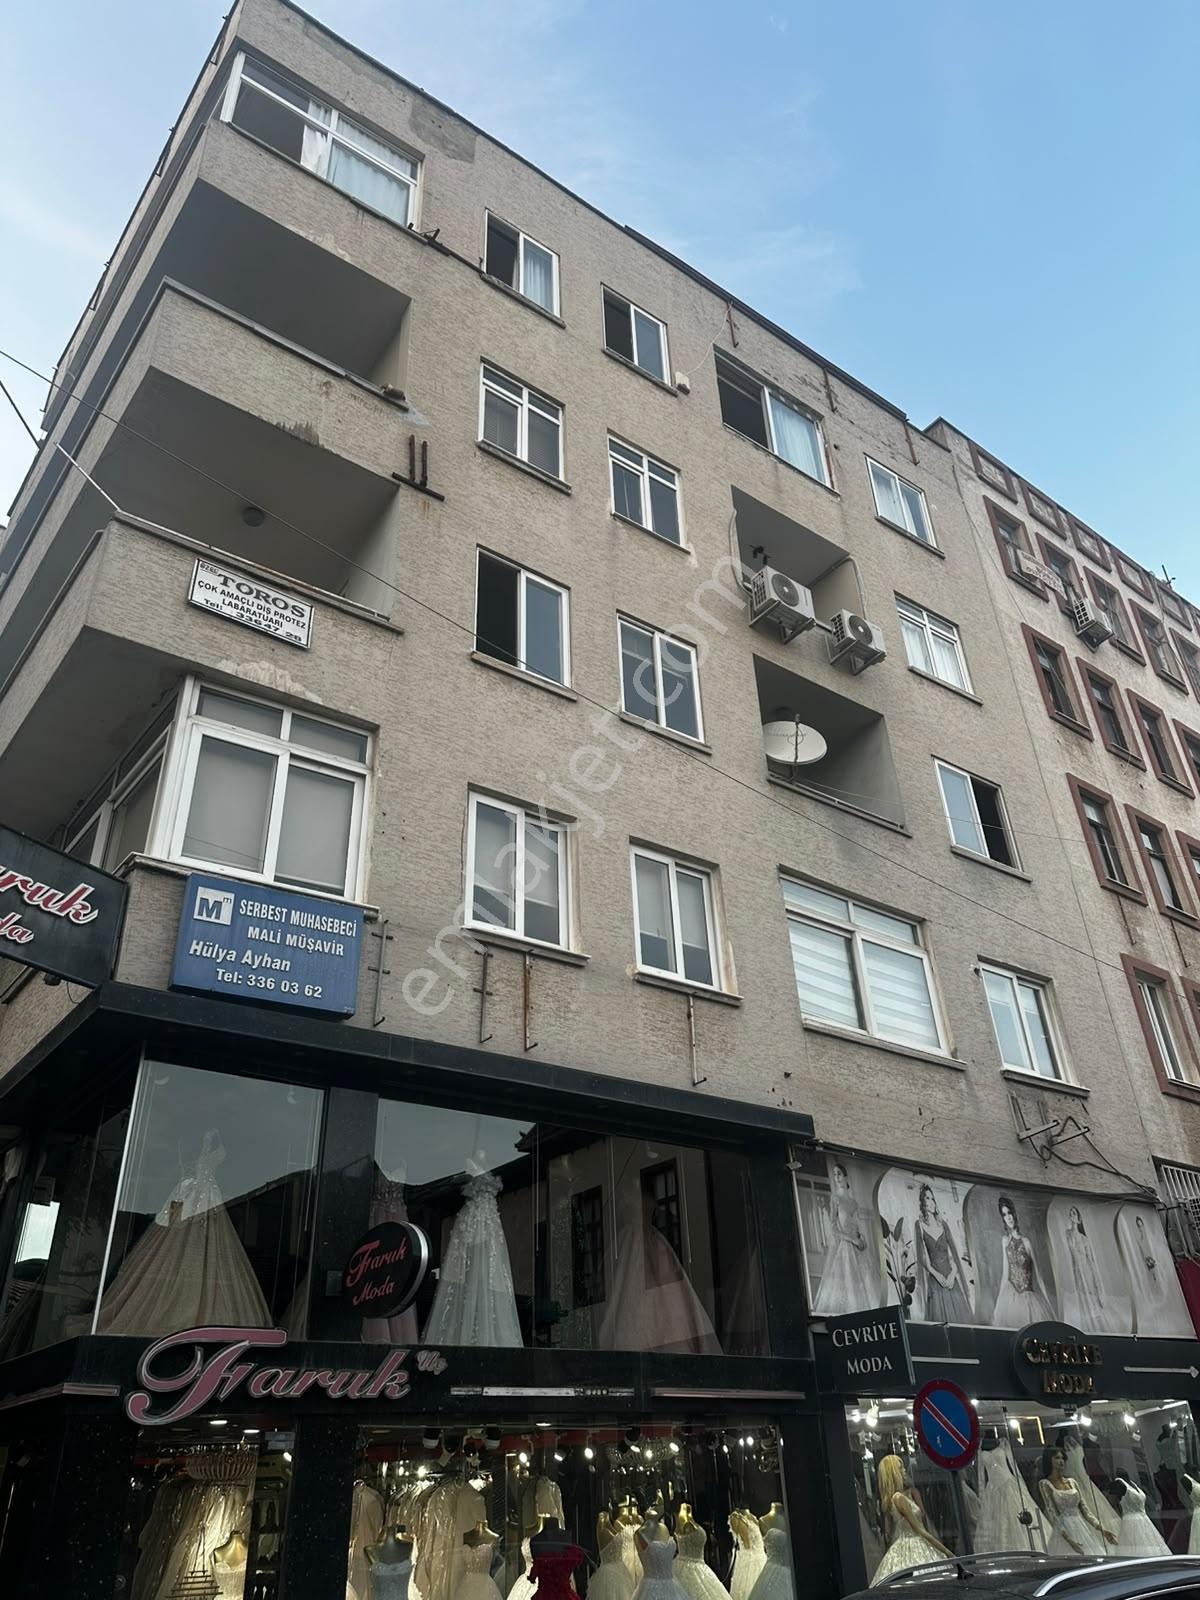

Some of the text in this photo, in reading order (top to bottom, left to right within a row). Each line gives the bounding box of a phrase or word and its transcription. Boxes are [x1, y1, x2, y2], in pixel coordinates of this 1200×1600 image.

[198, 580, 218, 593] ÇOK
[220, 590, 254, 607] AMAÇLI
[274, 612, 306, 629] PROTEZ
[218, 574, 305, 618] TOROS
[222, 599, 282, 628] LABARATUARI
[0, 865, 99, 925] ruk
[240, 899, 357, 937] SERBEST MUHASEBECİ
[189, 940, 291, 972] Hülya Ayhan
[248, 926, 344, 956] MALİ MÜŞAVİR
[216, 968, 323, 998] Tel: 336 03 62
[346, 1237, 407, 1287] Faruk
[352, 1275, 395, 1306] Moda
[832, 1321, 899, 1347] CEVRİYE
[126, 1326, 412, 1425] Faruk
[847, 1356, 893, 1375] MODA
